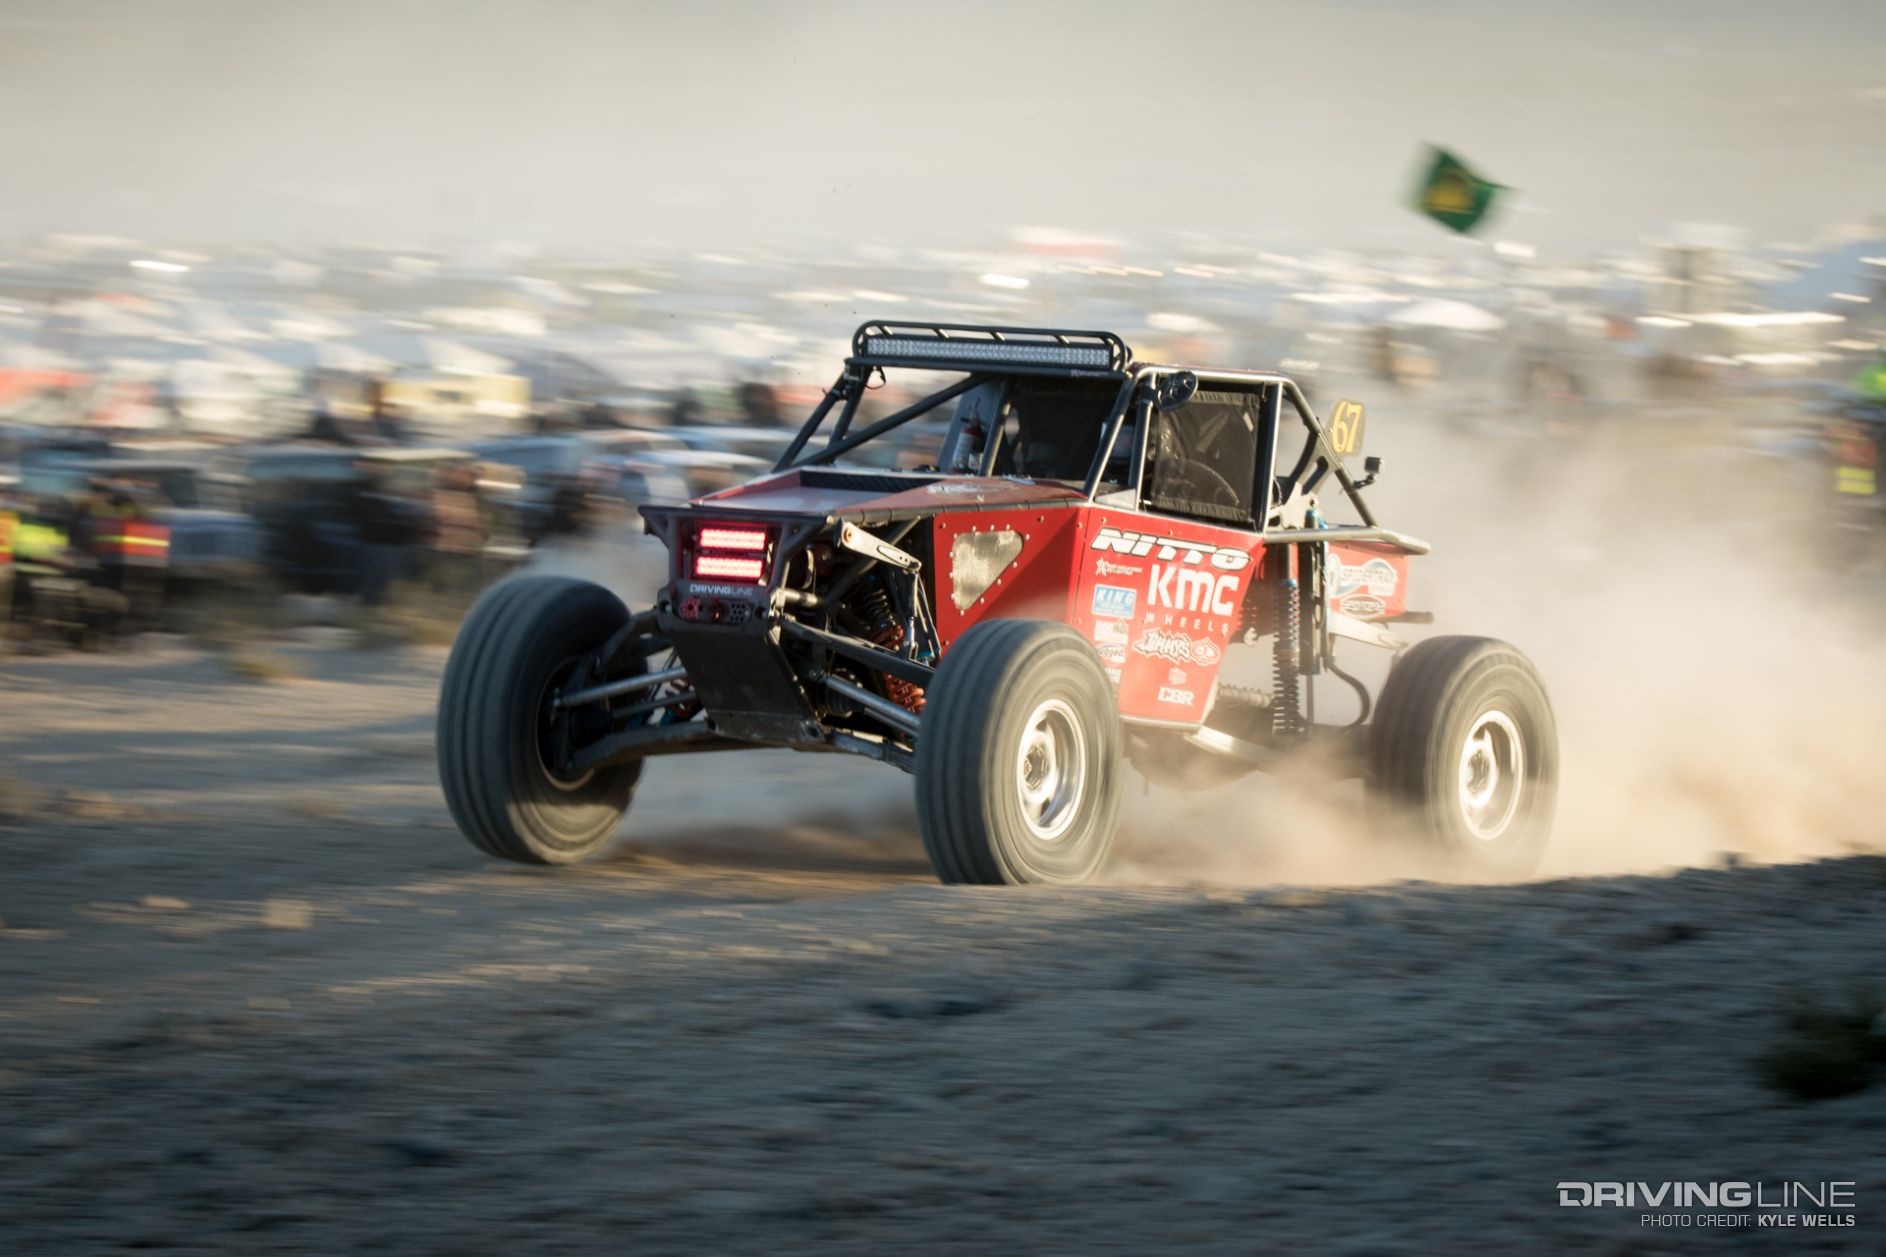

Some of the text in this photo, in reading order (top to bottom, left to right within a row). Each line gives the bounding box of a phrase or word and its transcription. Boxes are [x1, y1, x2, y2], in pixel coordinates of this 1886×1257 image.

[1332, 400, 1363, 453] 67
[1091, 527, 1253, 570] NITTO
[1097, 588, 1135, 604] KING
[1147, 564, 1239, 616] KMC
[1145, 612, 1230, 633] WHEELS
